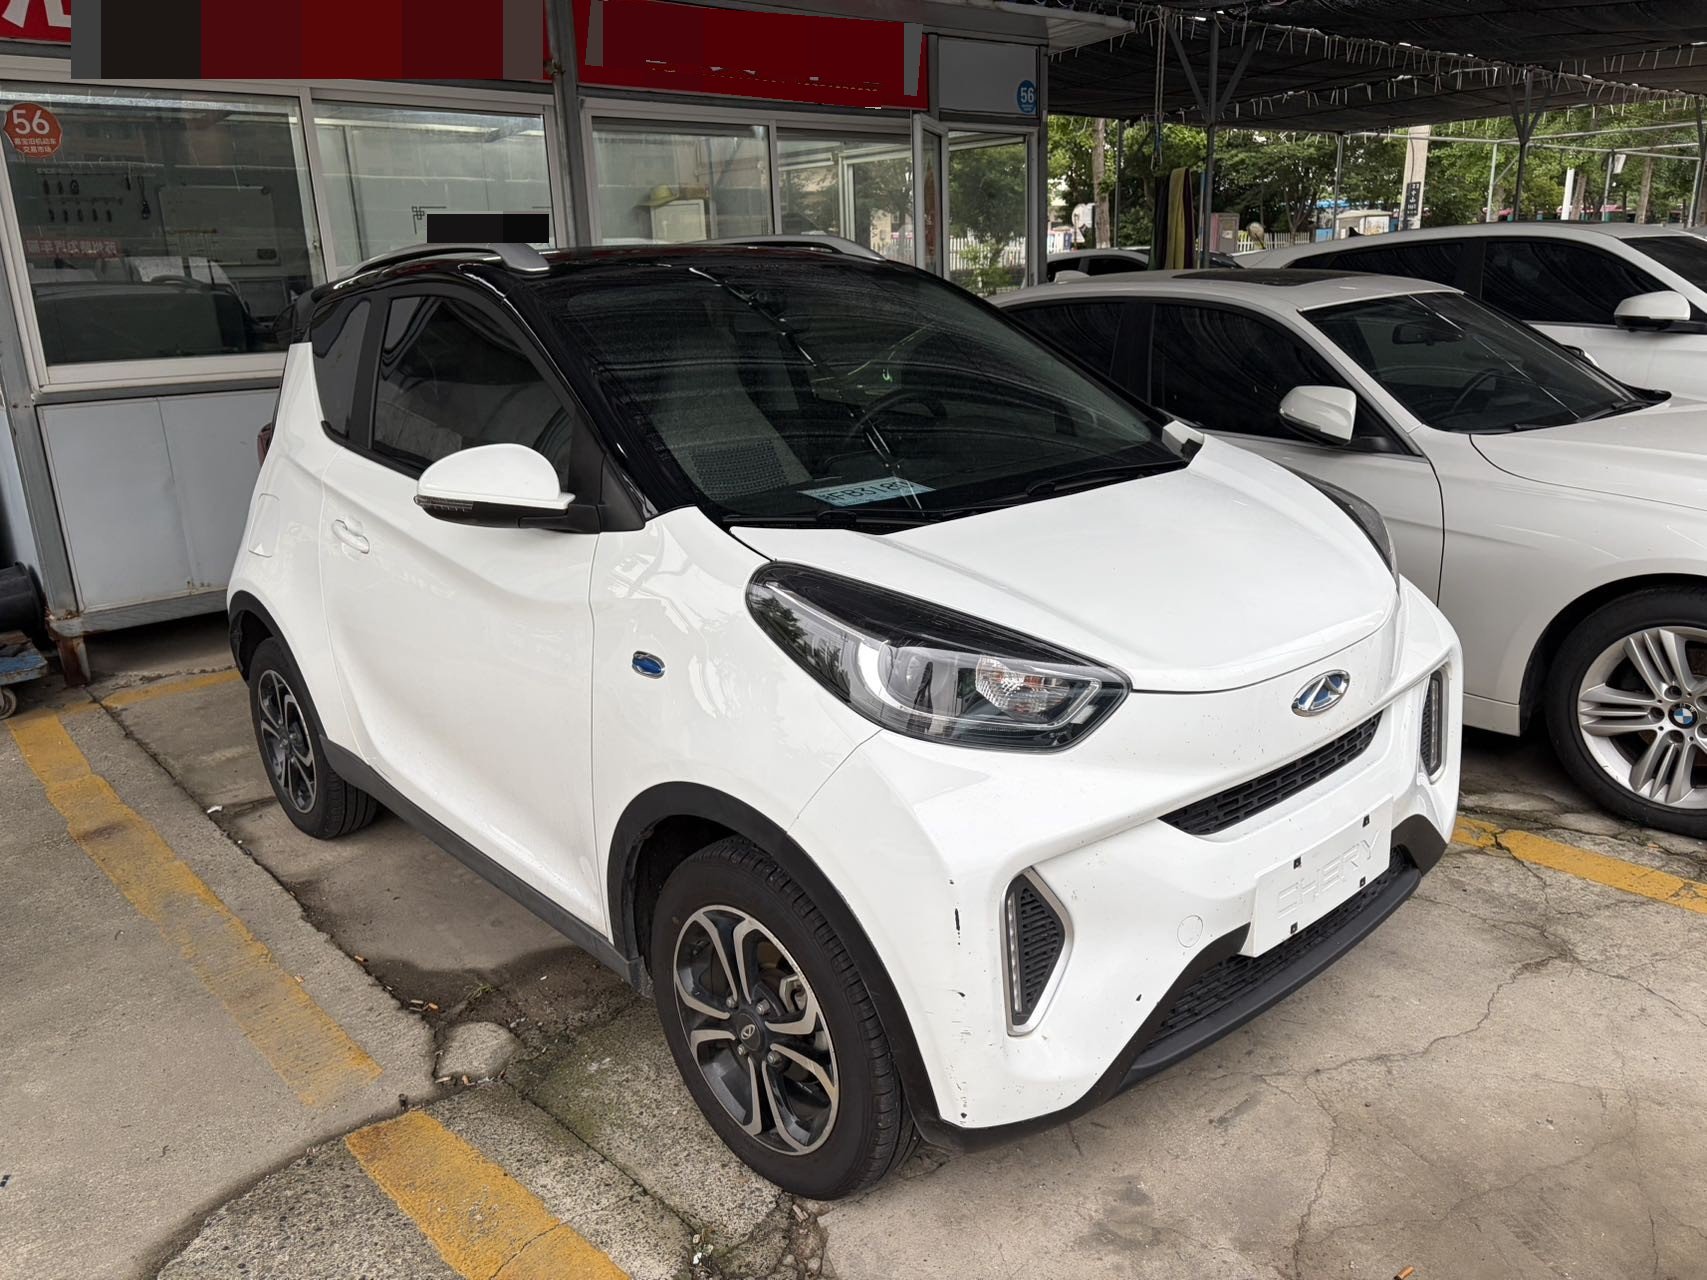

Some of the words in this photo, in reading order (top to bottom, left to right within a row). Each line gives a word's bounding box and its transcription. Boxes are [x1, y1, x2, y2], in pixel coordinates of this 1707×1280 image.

[1020, 87, 1035, 103] 56
[12, 109, 50, 135] 56
[1277, 830, 1381, 919] CHERY
